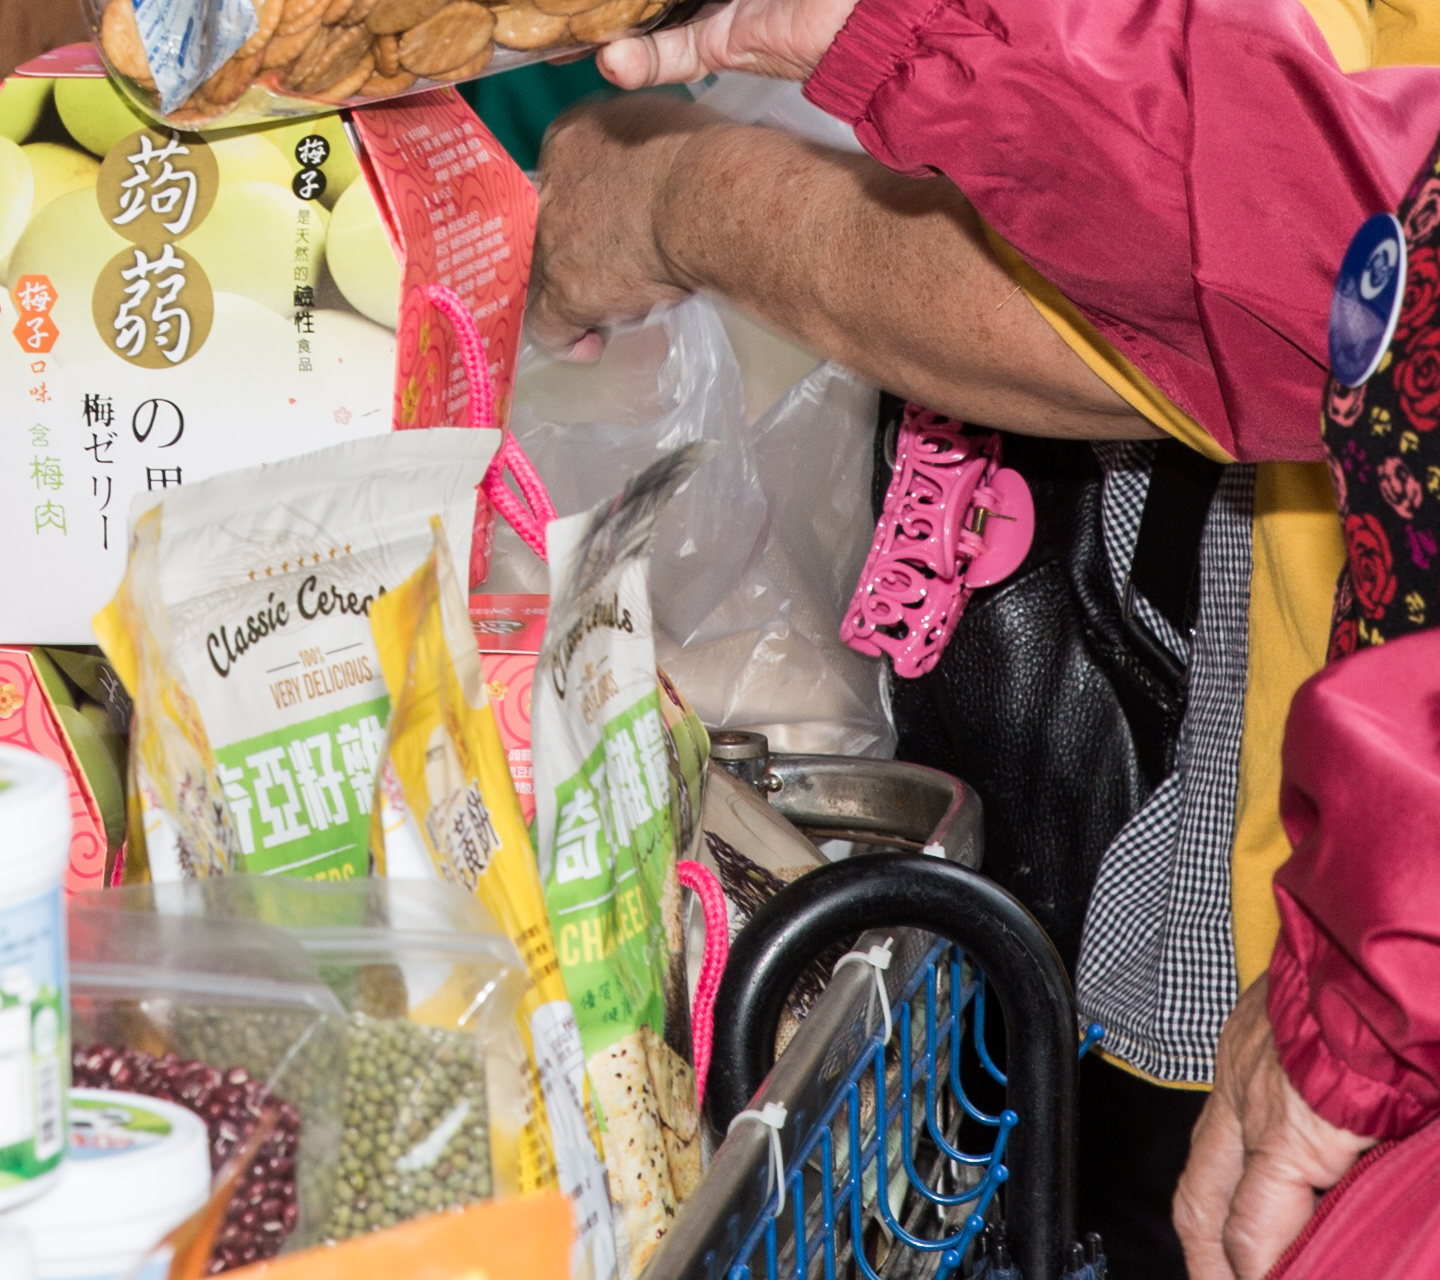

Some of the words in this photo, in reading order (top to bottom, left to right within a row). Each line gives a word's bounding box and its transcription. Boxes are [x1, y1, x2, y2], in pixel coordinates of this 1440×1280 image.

[296, 136, 328, 200] 梅子
[112, 130, 199, 364] 蒟蒻
[17, 281, 53, 349] 梅子
[29, 359, 53, 405] 口味
[28, 421, 68, 537] 含梅肉
[81, 392, 118, 551] 梅ゼリー
[206, 592, 290, 679] Classic
[269, 676, 304, 710] VERY
[304, 654, 374, 700] DELICIOUS
